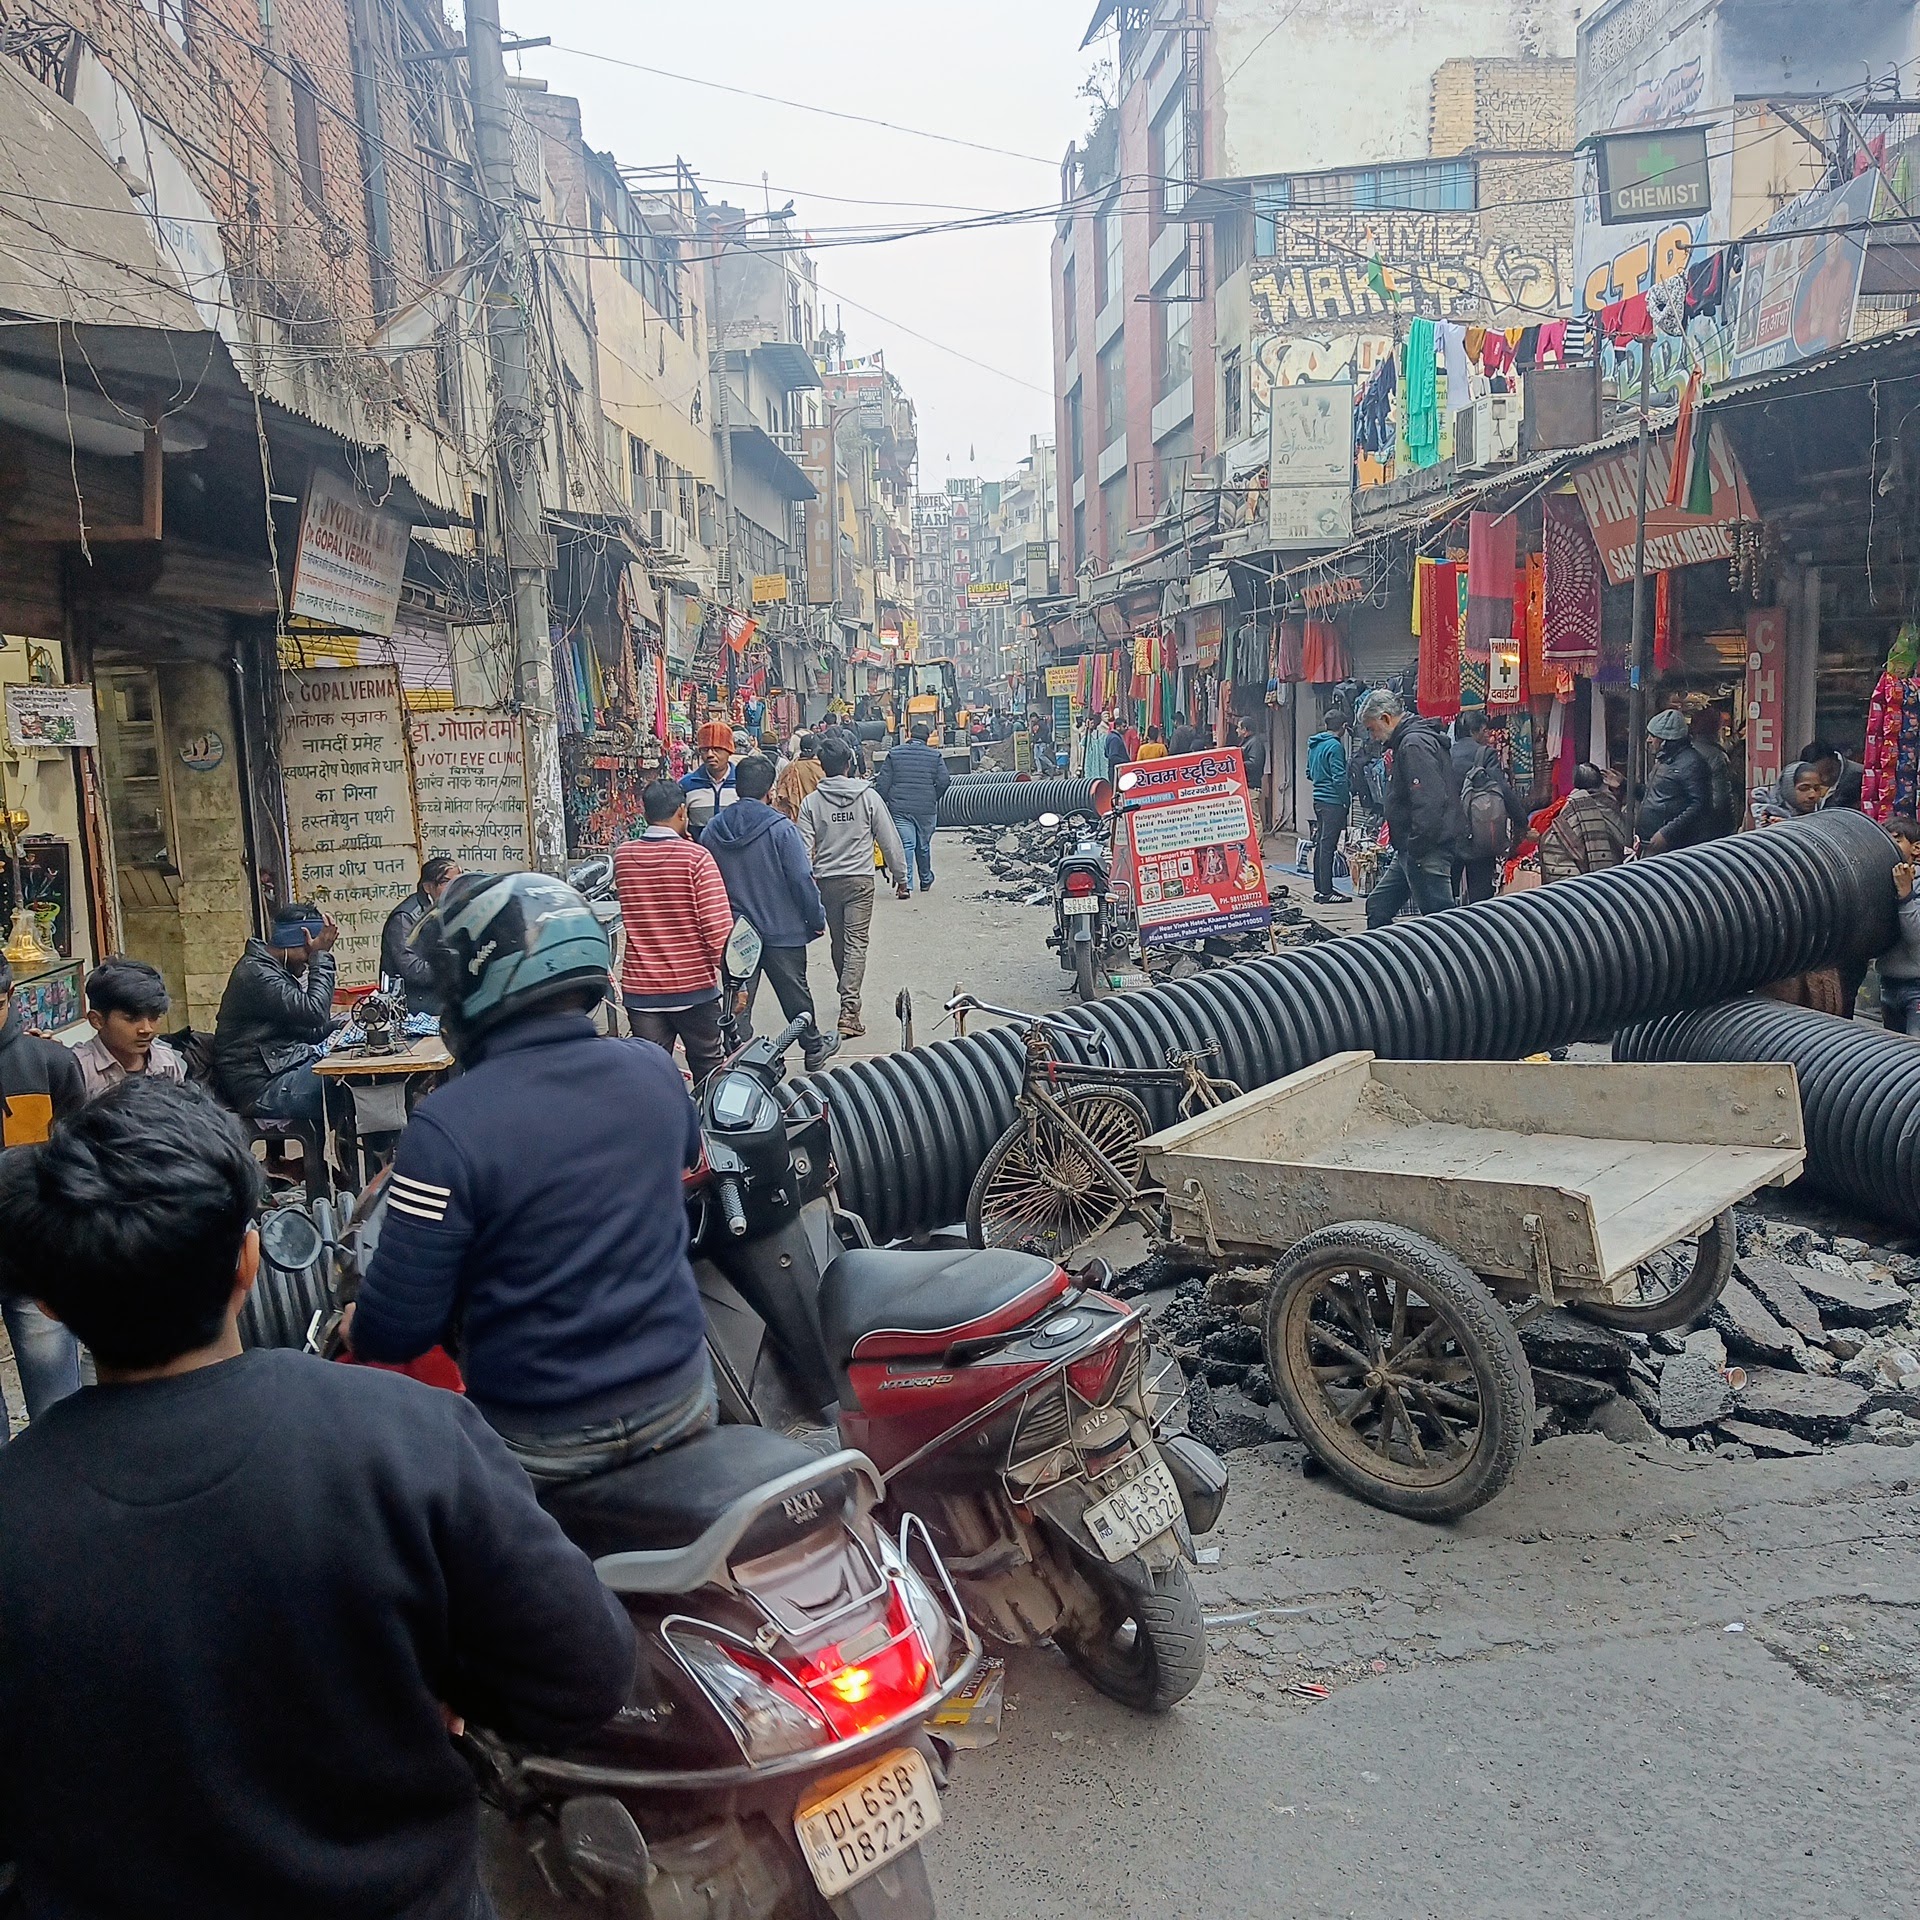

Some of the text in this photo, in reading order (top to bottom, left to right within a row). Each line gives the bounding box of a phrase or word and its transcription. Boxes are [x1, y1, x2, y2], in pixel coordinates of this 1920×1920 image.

[1617, 183, 1700, 210] CHEMIST
[811, 437, 829, 567] PAYAL
[315, 526, 343, 561] GOPAL
[344, 543, 373, 571] VERMA
[968, 581, 1009, 593] EVEREST CAFE
[438, 717, 487, 742] गोपाल
[489, 714, 517, 741] वर्मा
[416, 751, 522, 767] JYOTI EYE CLINIC
[319, 760, 339, 781] दोष
[1180, 755, 1237, 785] स्टूडियो
[315, 783, 378, 802] का गिरना
[447, 775, 472, 790] नाक
[474, 775, 498, 789] कान
[364, 805, 396, 825] पथरी
[444, 796, 474, 814] मोतिया
[1209, 806, 1244, 817] Photography
[831, 811, 855, 823] GEEIA
[1217, 822, 1246, 831] Anniversary
[457, 844, 498, 861] मोतिया
[1157, 851, 1179, 862] Passport
[1179, 849, 1195, 858] Photo
[301, 861, 335, 882] ईलाज
[373, 858, 406, 874] पतन
[388, 881, 413, 901] होना
[359, 908, 381, 925] सिर
[1159, 924, 1173, 932] Near
[1174, 921, 1190, 930] Vivek
[1207, 914, 1229, 924] Khanna
[1229, 911, 1251, 921] Cinema
[1149, 933, 1163, 942] Main
[1181, 927, 1198, 937] Pahar
[1214, 922, 1227, 931] New
[1080, 1410, 1109, 1436] TVS
[1100, 1526, 1114, 1540] IND
[825, 1766, 914, 1841] DL6SB
[837, 1800, 926, 1876] D8223
